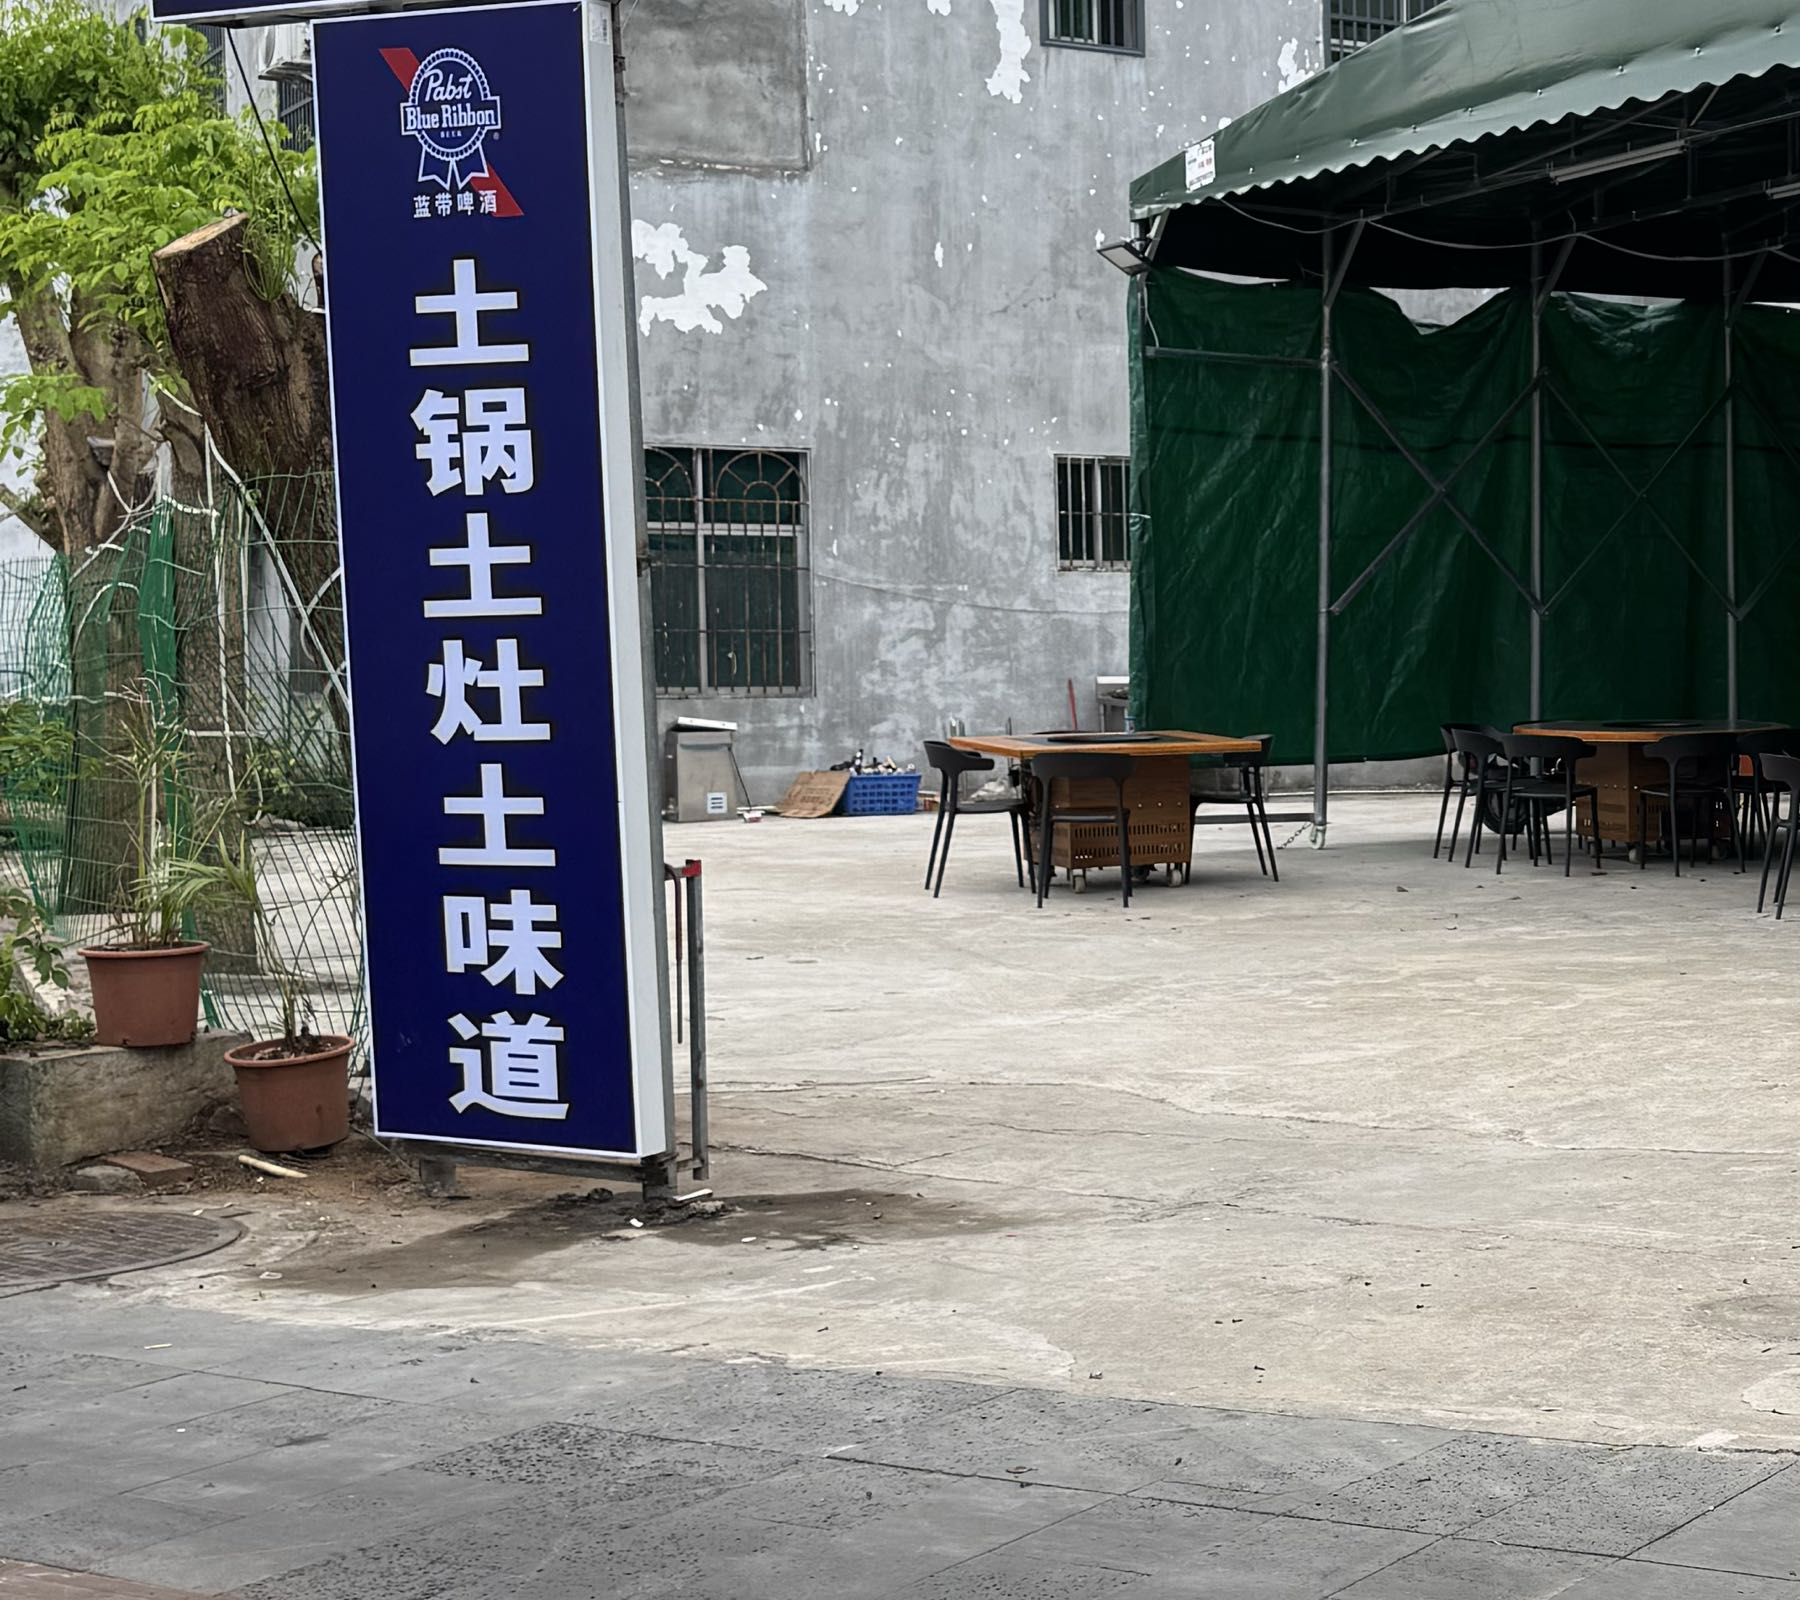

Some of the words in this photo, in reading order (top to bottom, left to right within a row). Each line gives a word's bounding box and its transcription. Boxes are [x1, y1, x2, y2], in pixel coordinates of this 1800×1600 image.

[424, 68, 474, 102] Pabst
[405, 106, 440, 131] Blue
[440, 104, 496, 128] Ribbon
[413, 189, 497, 218] 蓝带啤酒
[409, 258, 570, 1120] 土锅土灶土味道
